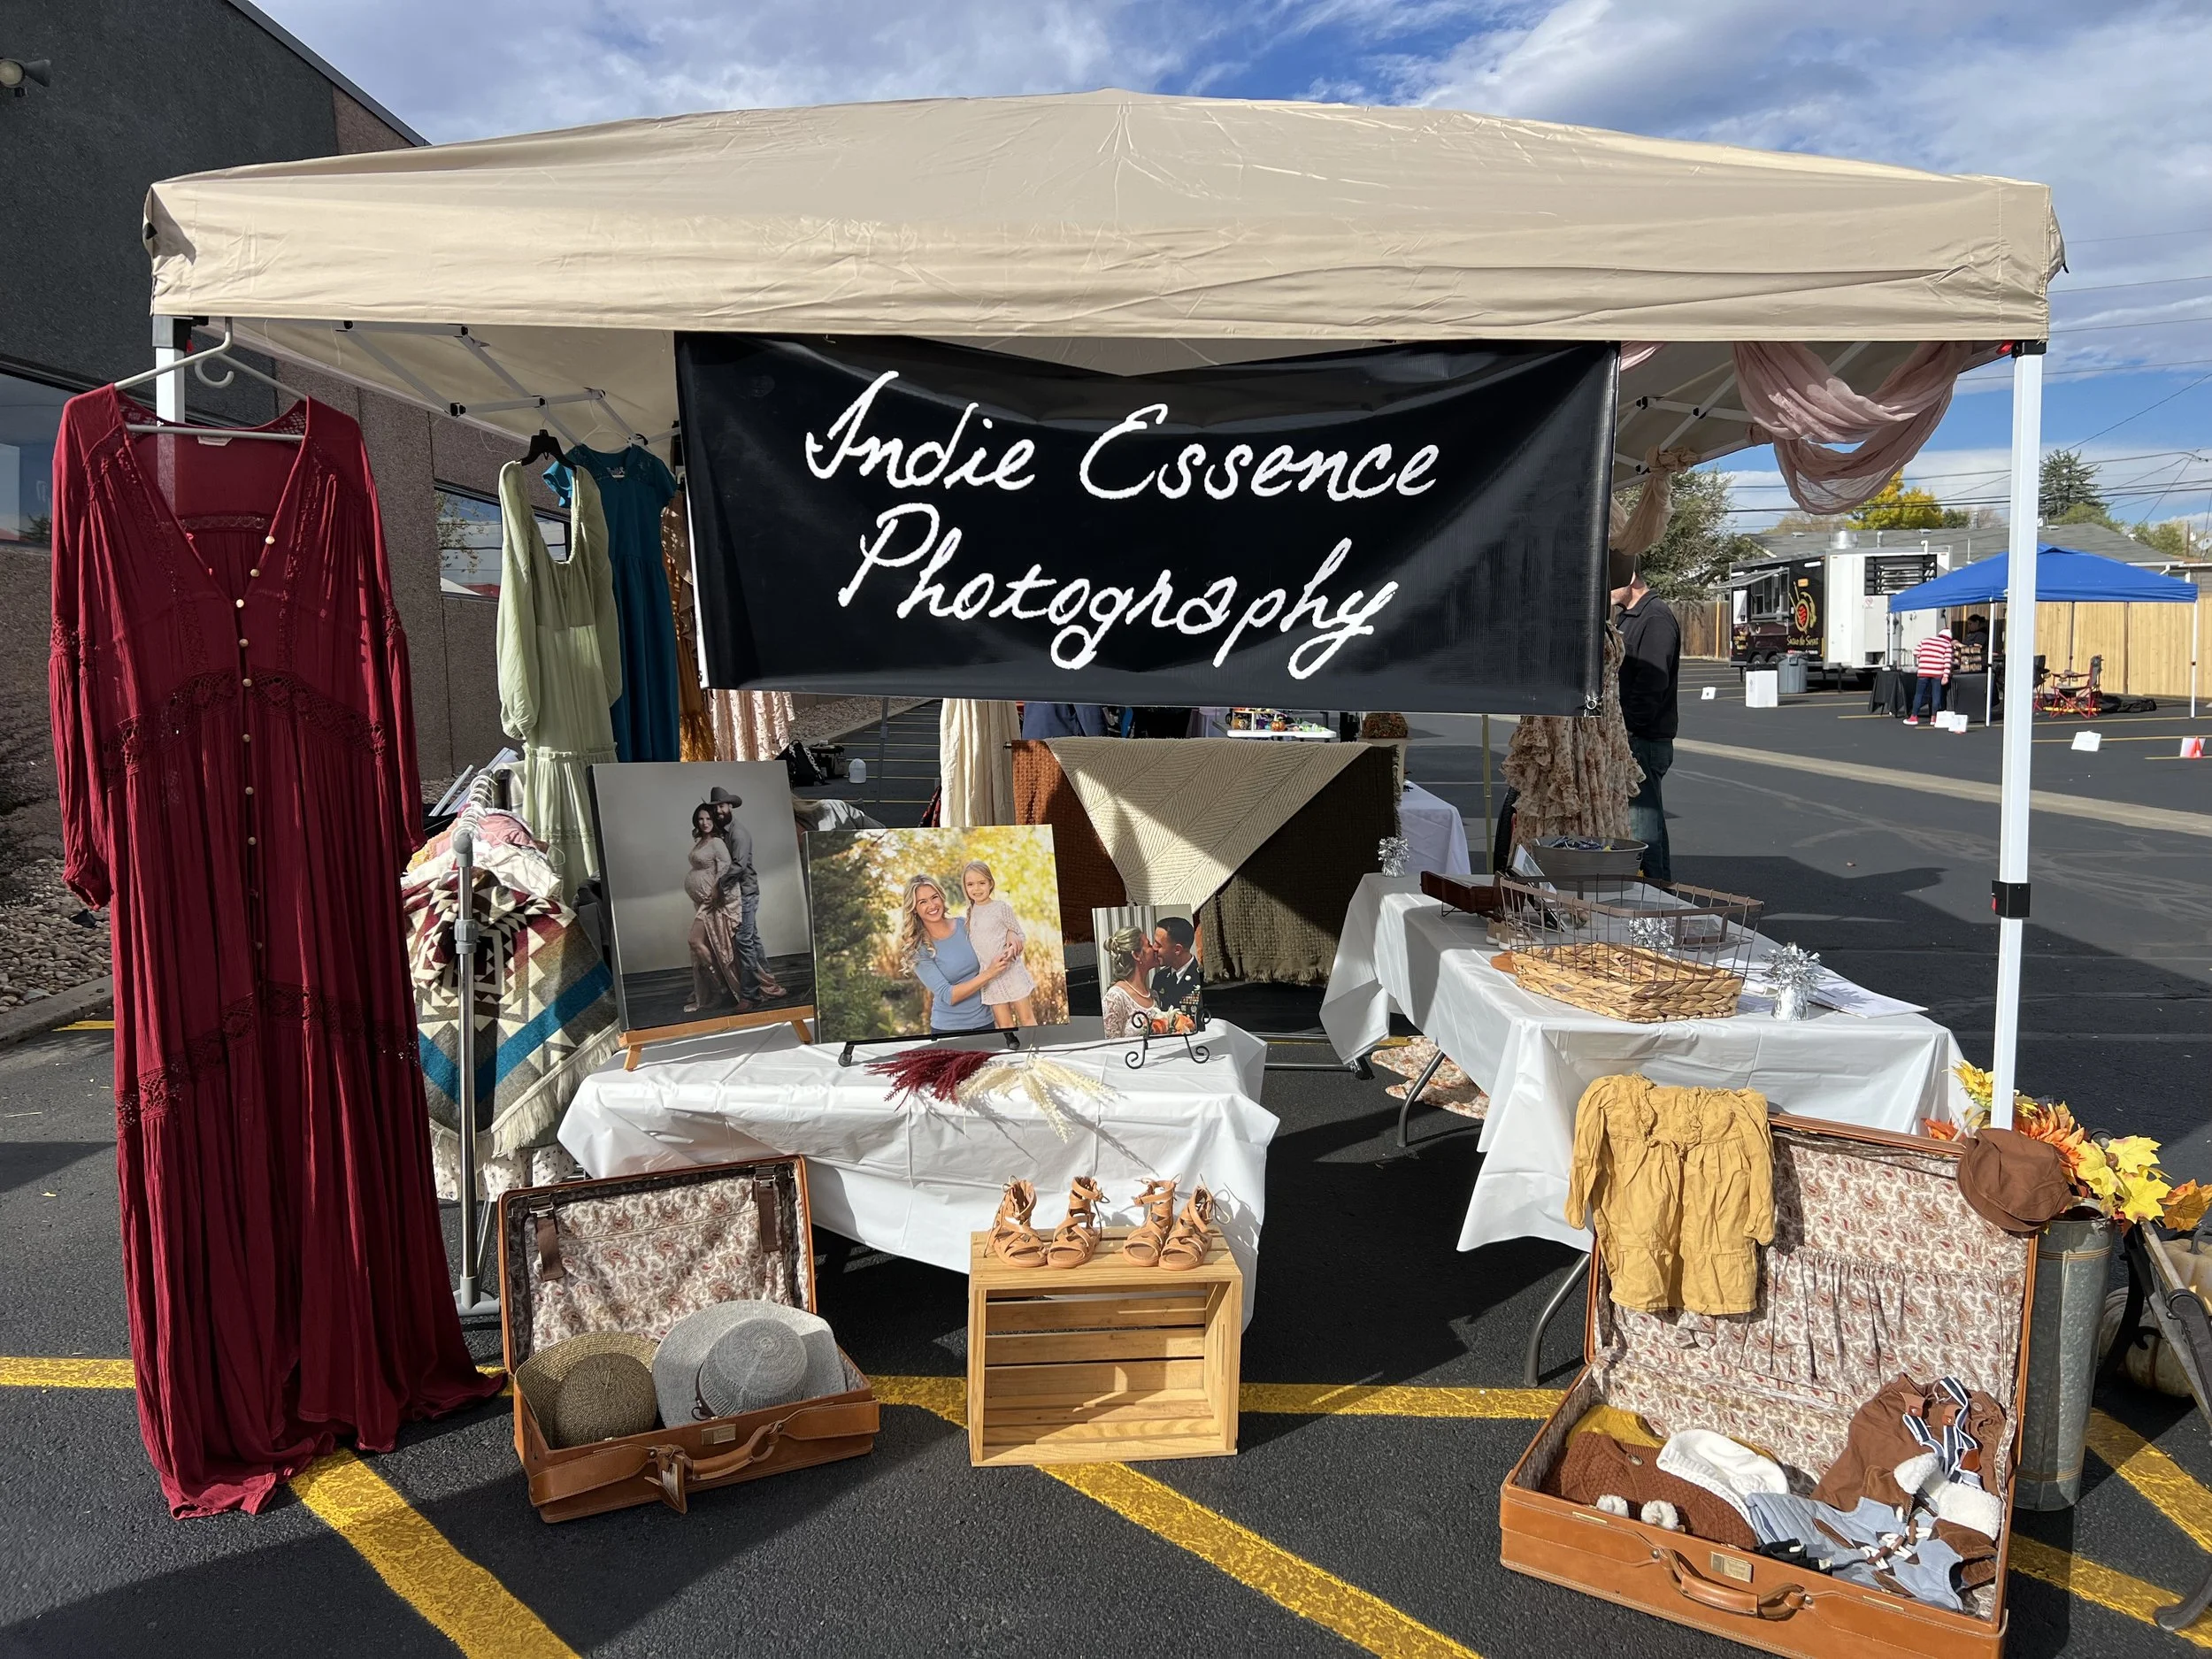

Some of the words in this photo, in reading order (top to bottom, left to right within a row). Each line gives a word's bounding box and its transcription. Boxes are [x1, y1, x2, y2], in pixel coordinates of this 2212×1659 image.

[805, 370, 1036, 491] Indie
[1079, 403, 1440, 503] Essence
[837, 502, 1400, 680] Photography
